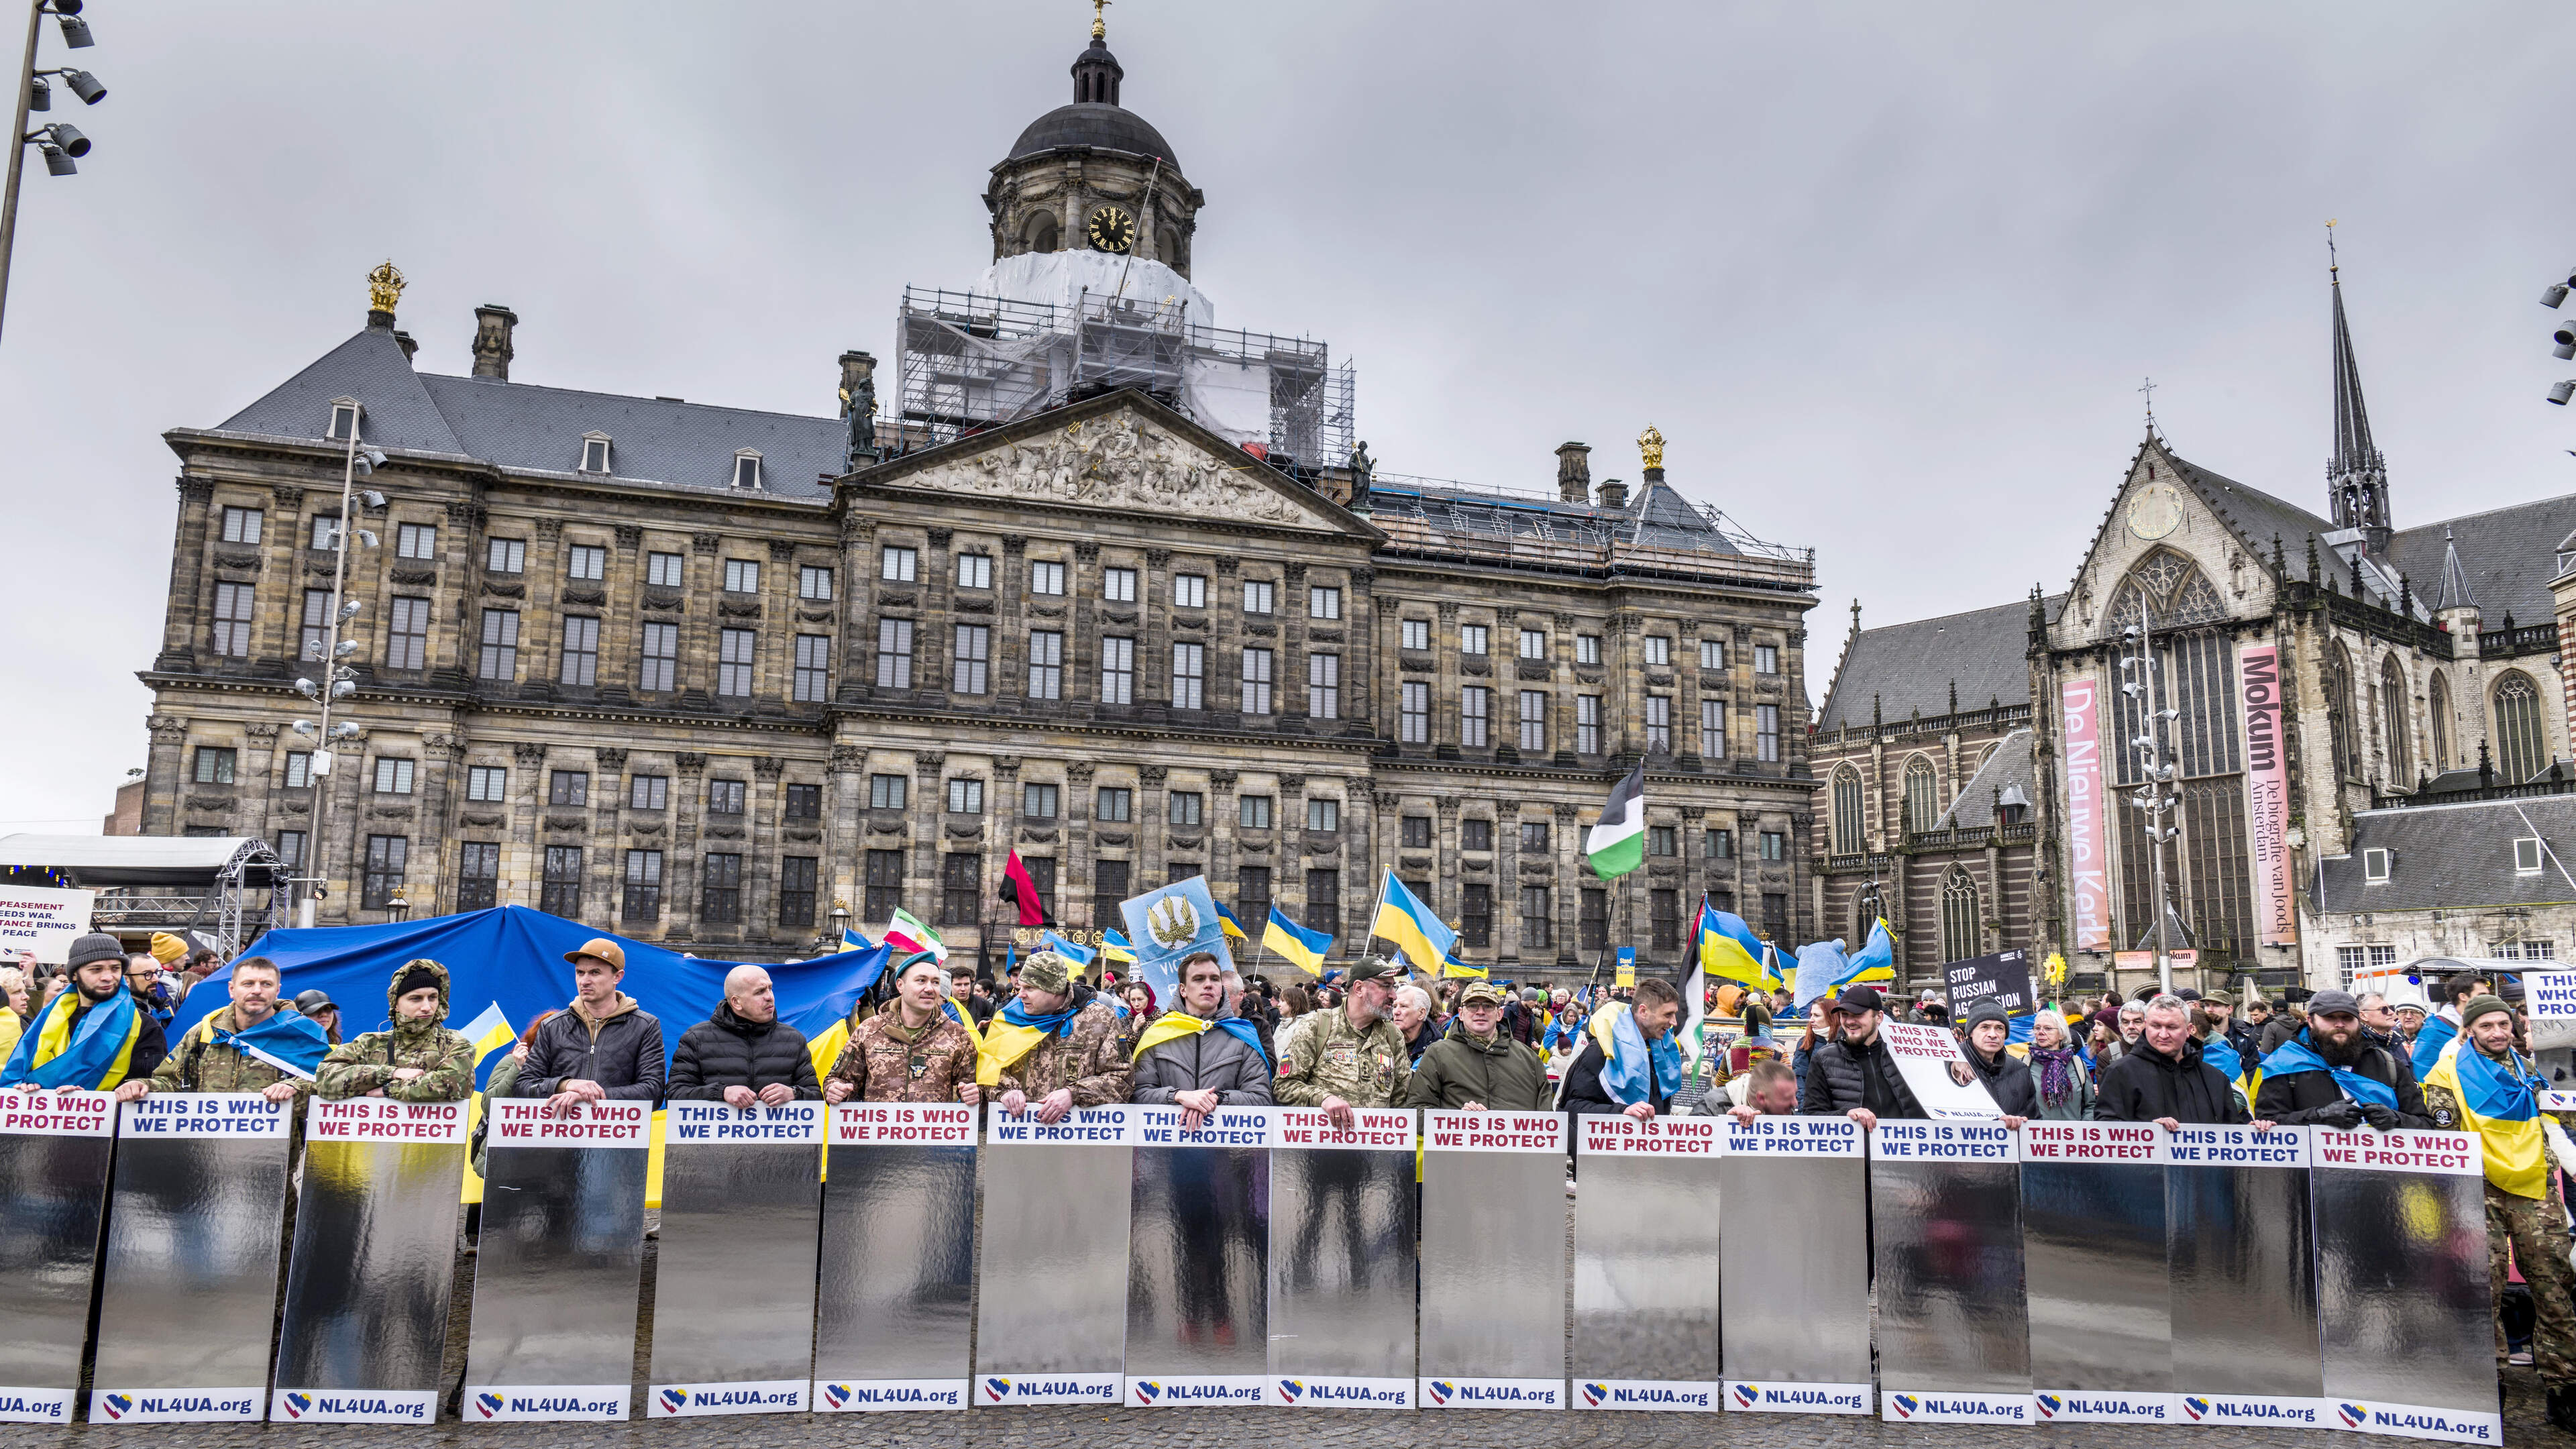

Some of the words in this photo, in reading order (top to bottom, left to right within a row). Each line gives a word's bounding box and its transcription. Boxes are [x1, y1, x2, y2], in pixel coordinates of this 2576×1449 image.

[2063, 688, 2092, 733] De
[2243, 655, 2279, 771] Mokum
[2266, 780, 2280, 798] De
[2066, 740, 2098, 863] Nieuwe
[2253, 782, 2269, 862] Amsterdam
[2266, 801, 2286, 863] biografie
[2271, 865, 2284, 891] van
[2074, 870, 2108, 944] Kerk
[2271, 894, 2292, 932] Joods
[1950, 967, 1976, 983] STOP
[1952, 979, 1997, 1000] RUSSIAN
[1888, 1025, 1921, 1035] THIS
[1925, 1028, 1939, 1037] IS
[1890, 1035, 1923, 1046] WHO
[1926, 1039, 1948, 1048] WE
[1894, 1046, 1957, 1058] PROTECT
[28, 1097, 47, 1110] IS
[57, 1097, 107, 1112] WHO
[134, 1100, 188, 1114] THIS
[198, 1100, 218, 1114] IS
[228, 1100, 280, 1114] WHO
[319, 1104, 369, 1118] THIS
[379, 1106, 398, 1118] IS
[407, 1106, 457, 1120] WHO
[502, 1106, 553, 1120] THIS
[591, 1107, 641, 1120] WHO
[679, 1108, 729, 1120] THIS
[738, 1108, 757, 1120] IS
[765, 1108, 814, 1120] WHO
[840, 1110, 887, 1122] THIS
[896, 1110, 914, 1122] IS
[923, 1110, 969, 1123] WHO
[1079, 1111, 1124, 1124] WHO
[5, 1114, 105, 1130] PROTECT
[133, 1118, 168, 1132] WE
[176, 1118, 279, 1132] PROTECT
[1222, 1115, 1265, 1128] WHO
[1283, 1114, 1328, 1126] THIS
[1362, 1116, 1407, 1128] WHO
[1434, 1117, 1479, 1130] THIS
[1488, 1118, 1505, 1130] IS
[1513, 1119, 1558, 1131] WHO
[319, 1122, 350, 1135] WE
[358, 1123, 456, 1137] PROTECT
[501, 1124, 533, 1136] WE
[541, 1124, 640, 1138] PROTECT
[679, 1125, 710, 1138] WE
[718, 1125, 814, 1138] PROTECT
[840, 1126, 869, 1139] WE
[877, 1127, 969, 1140] PROTECT
[998, 1127, 1028, 1139] WE
[1035, 1127, 1124, 1140] PROTECT
[1144, 1129, 1172, 1142] WE
[1179, 1130, 1266, 1144] PROTECT
[1588, 1122, 1633, 1134] THIS
[1642, 1122, 1659, 1135] IS
[1668, 1124, 1712, 1136] WHO
[1728, 1122, 1774, 1134] THIS
[1782, 1123, 1800, 1135] IS
[1808, 1123, 1854, 1136] WHO
[1880, 1126, 1927, 1139] THIS
[1935, 1127, 1953, 1139] IS
[1961, 1128, 2007, 1140] WHO
[2029, 1128, 2074, 1140] THIS
[2083, 1128, 2100, 1140] IS
[2108, 1128, 2153, 1142] WHO
[1284, 1130, 1311, 1142] WE
[1320, 1131, 1407, 1145] PROTECT
[1434, 1134, 1462, 1146] WE
[1470, 1134, 1558, 1147] PROTECT
[1588, 1138, 1616, 1150] WE
[1624, 1138, 1712, 1152] PROTECT
[1729, 1138, 1758, 1150] WE
[1766, 1139, 1854, 1152] PROTECT
[2169, 1131, 2216, 1144] THIS
[2225, 1132, 2243, 1144] IS
[2251, 1132, 2298, 1145] WHO
[2321, 1132, 2374, 1146] THIS
[2383, 1135, 2404, 1148] IS
[2414, 1136, 2468, 1151] WHO
[1882, 1143, 1911, 1155] WE
[1919, 1143, 2008, 1157] PROTECT
[2030, 1144, 2059, 1157] WE
[2066, 1144, 2155, 1158] PROTECT
[2171, 1147, 2200, 1159] WE
[2208, 1148, 2298, 1161] PROTECT
[2323, 1149, 2356, 1163] WE
[2365, 1151, 2469, 1168] PROTECT
[859, 1389, 957, 1404] NL4UA.org
[1018, 1383, 1113, 1397] NL4UA.org
[1167, 1385, 1260, 1401] NL4UA.org
[1311, 1386, 1405, 1404] NL4UA.org
[1461, 1387, 1554, 1403] NL4UA.org
[1615, 1389, 1708, 1406] NL4UA.org
[141, 1398, 252, 1414] NL4UA.org
[695, 1391, 798, 1406] NL4UA.org
[1766, 1391, 1862, 1408] NL4UA.org
[319, 1399, 425, 1417] NL4UA.org
[512, 1399, 618, 1415] NL4UA.org
[1926, 1401, 2023, 1419] NL4UA.org
[2069, 1401, 2165, 1418] NL4UA.org
[2216, 1403, 2315, 1421] NL4UA.org
[2375, 1412, 2489, 1438] NL4UA.org
